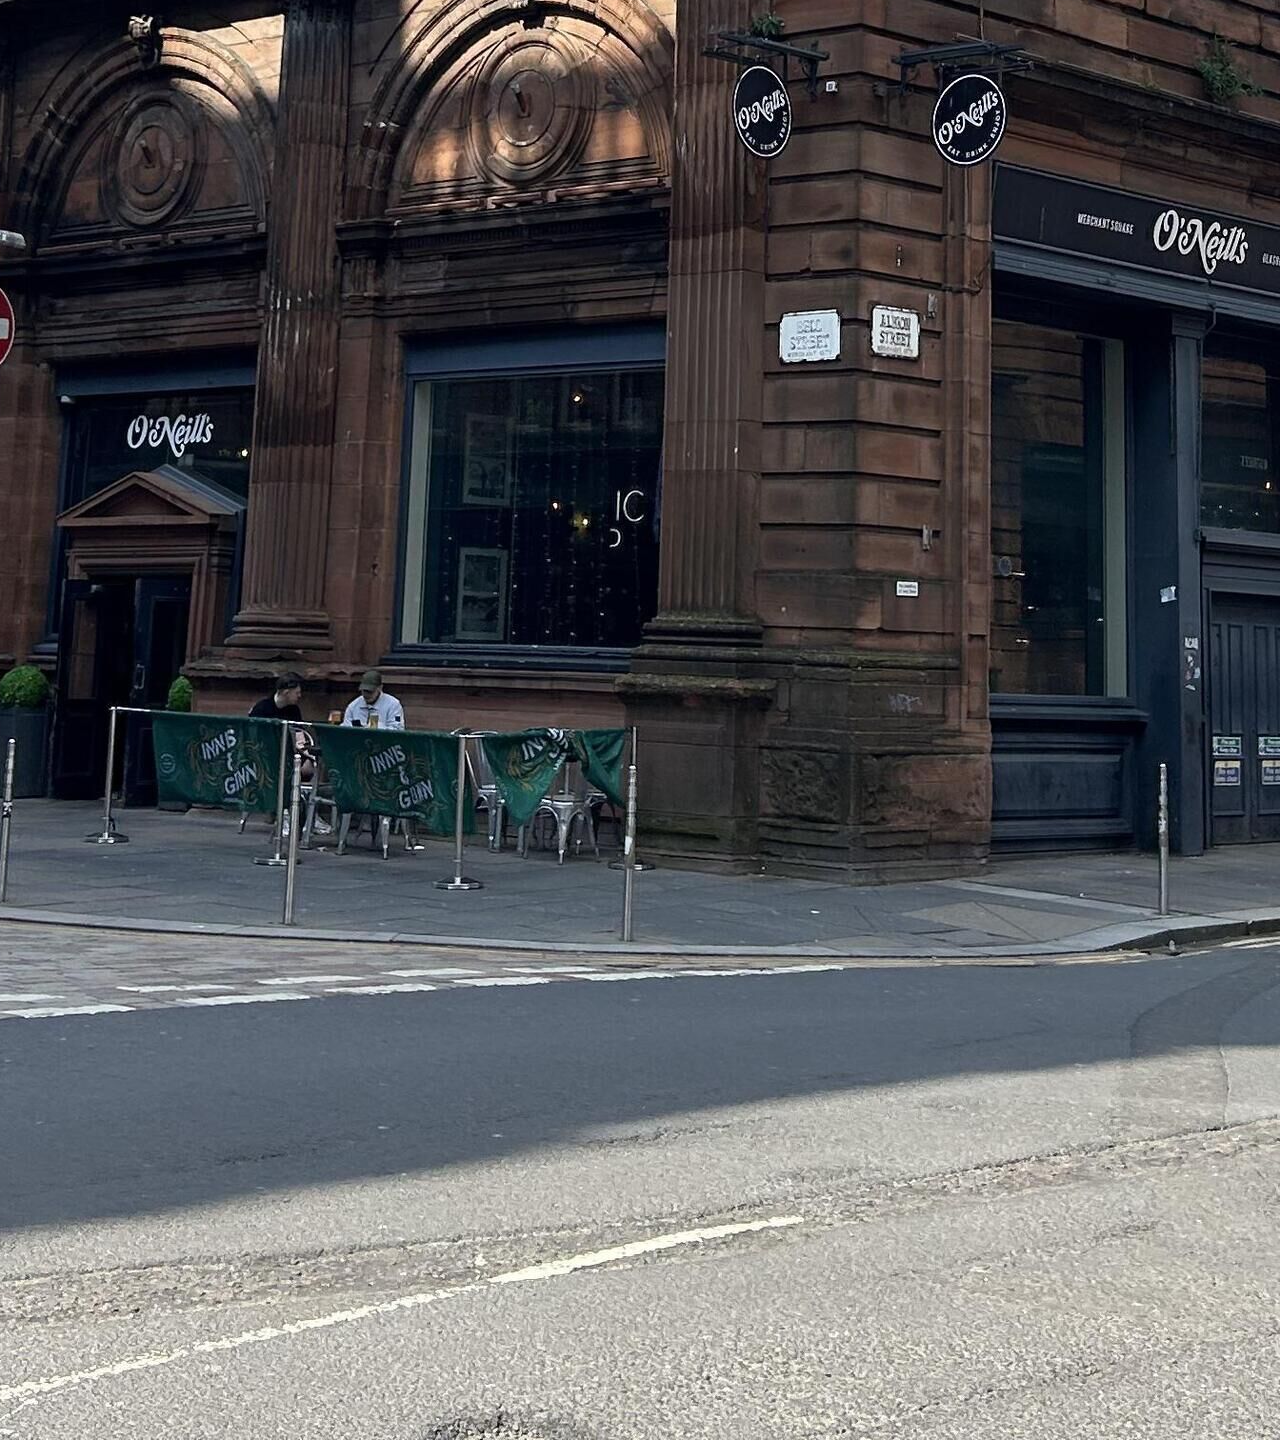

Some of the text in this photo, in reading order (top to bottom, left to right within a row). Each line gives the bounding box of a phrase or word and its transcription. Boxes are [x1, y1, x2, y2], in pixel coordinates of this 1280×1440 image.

[738, 89, 786, 131] O'Neill's
[938, 91, 999, 145] O'Neill's
[1077, 213, 1111, 230] MERCHANT
[1153, 209, 1249, 275] O'Neill's
[790, 333, 830, 351] STREET
[880, 330, 911, 347] STREET
[127, 413, 214, 458] O'Neill's
[371, 744, 406, 774] INNIS
[398, 779, 434, 809] GUNN
